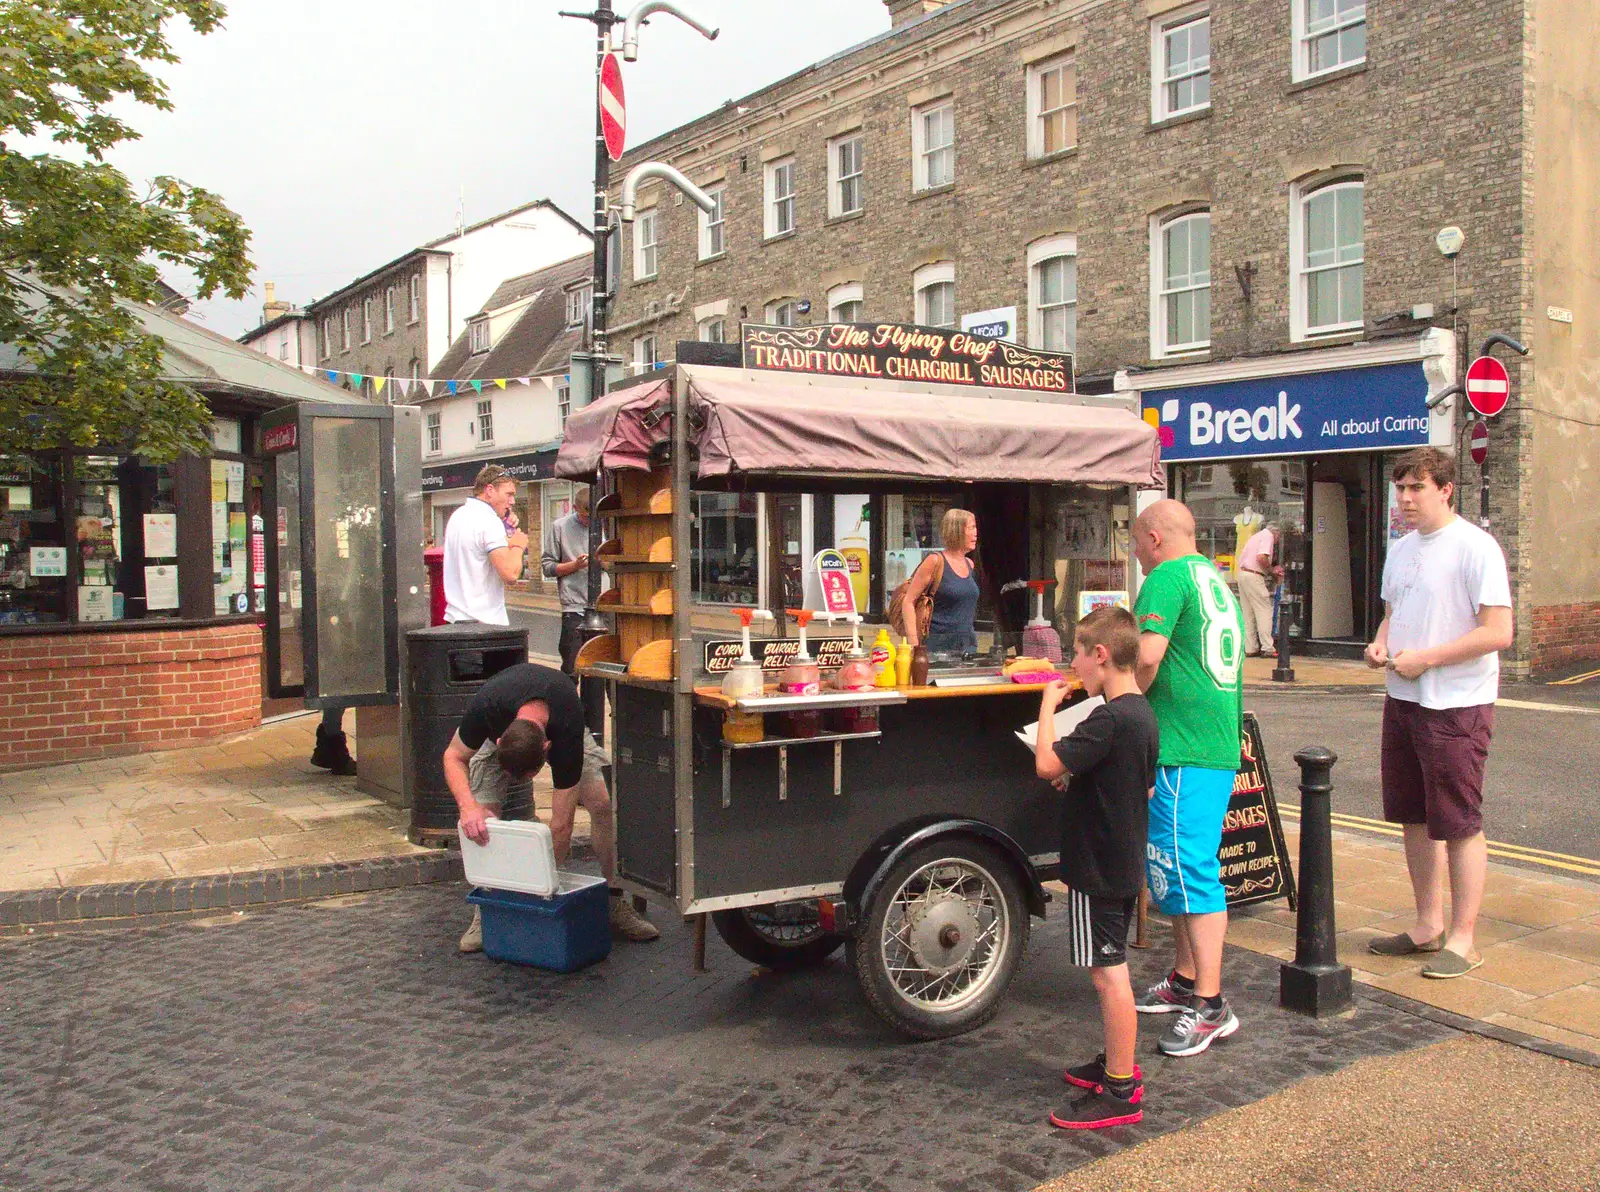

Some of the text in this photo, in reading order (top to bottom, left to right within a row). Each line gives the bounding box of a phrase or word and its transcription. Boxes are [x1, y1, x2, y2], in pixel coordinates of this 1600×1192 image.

[827, 324, 999, 365] The Flying Chef
[752, 345, 1067, 390] TRADITIONAL CHARGRILL SAUSAGES
[1190, 390, 1303, 446] Break
[1320, 414, 1429, 437] All about Caring
[831, 577, 841, 589] 3
[1188, 560, 1244, 691] 8
[715, 644, 745, 657] CORN
[819, 640, 855, 653] HEINZ
[708, 656, 740, 670] RELI
[763, 654, 797, 667] RELIS
[816, 653, 845, 666] KETCH
[1241, 739, 1257, 762] AL
[1231, 770, 1266, 795] RILL
[1222, 803, 1267, 832] USAGES
[1219, 840, 1257, 859] MADE TO
[1228, 860, 1248, 877] OWN
[1248, 854, 1273, 872] RECIPE
